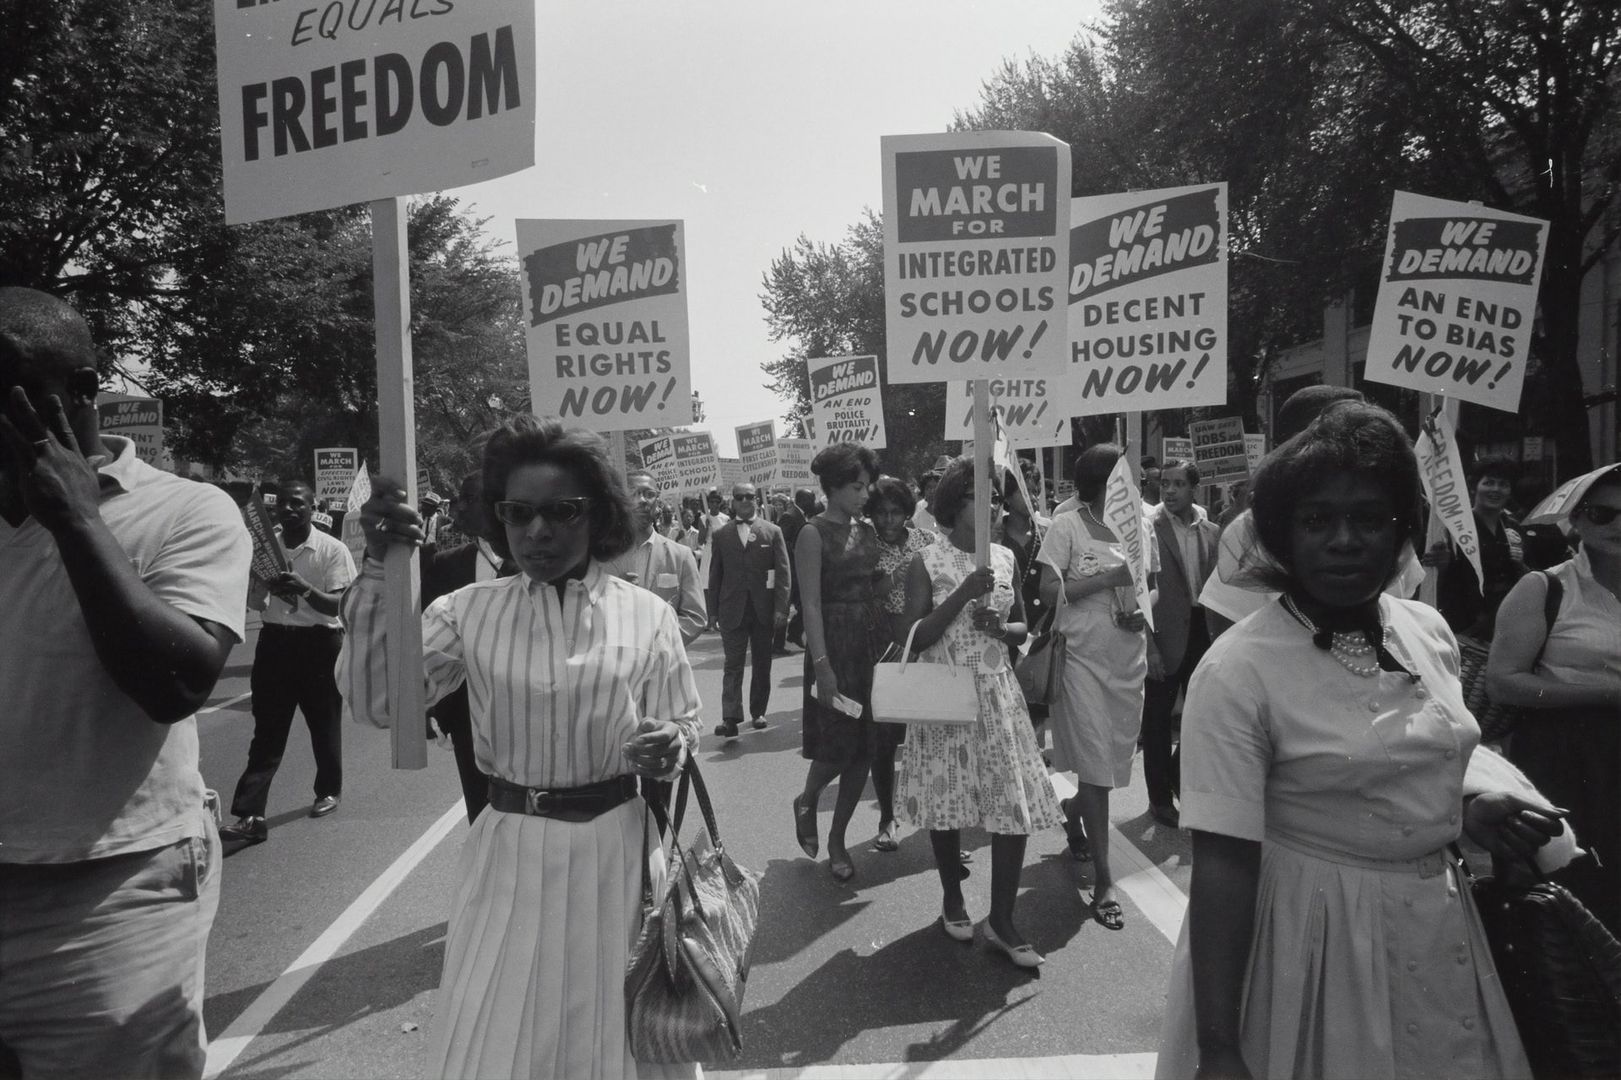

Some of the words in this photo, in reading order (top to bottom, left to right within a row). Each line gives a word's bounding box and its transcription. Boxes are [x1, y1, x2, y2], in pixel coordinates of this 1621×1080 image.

[241, 25, 520, 161] FREEDOM
[954, 155, 1001, 180] WE
[909, 183, 1045, 217] MARCH
[952, 219, 1005, 235] FOR
[1109, 204, 1167, 248] WE
[1441, 221, 1497, 246] WE
[576, 235, 630, 272] WE
[898, 246, 1056, 279] INTEGRATED
[1069, 225, 1214, 295] DEMAND
[1398, 248, 1533, 276] DEMAND
[540, 257, 673, 315] DEMAND
[899, 286, 1055, 318] SCHOOLS
[1083, 293, 1206, 327] DECENT
[1397, 287, 1446, 314] AN
[1456, 296, 1522, 330] END
[555, 320, 667, 347] EQUAL
[911, 319, 1048, 366] NOW!
[1072, 328, 1218, 363] HOUSING
[1397, 314, 1437, 340] TO
[1446, 323, 1516, 358] BIAS
[555, 350, 672, 378] RIGHTS
[832, 361, 855, 379] WE
[1081, 353, 1210, 399] NOW!
[1391, 344, 1512, 390] NOW!
[559, 376, 677, 418] NOW!
[817, 370, 874, 399] DEMAND
[965, 380, 1047, 397] RGHTS
[118, 402, 140, 413] WE
[823, 399, 842, 408] AN
[846, 397, 871, 407] END
[834, 410, 864, 420] POLICE
[103, 411, 158, 427] DEMAND
[826, 419, 871, 430] BRUTALITY
[654, 439, 670, 452] WE
[743, 433, 771, 448] MARCH
[827, 424, 879, 445] NOW!
[1195, 431, 1226, 447] JOBS
[677, 442, 709, 453] MARCH
[743, 453, 759, 464] FIRST
[760, 449, 776, 459] CLASS
[1196, 444, 1245, 461] FREEDOM
[677, 456, 715, 468] INTEGRATED
[680, 465, 717, 477] SCHOOLS
[742, 458, 777, 473] CITIZENSHIP
[782, 470, 809, 478] REEDOM
[685, 473, 716, 488] NOW!
[749, 468, 777, 484] NOW!
[246, 502, 264, 535] MARCH
[1454, 519, 1465, 532] IN
